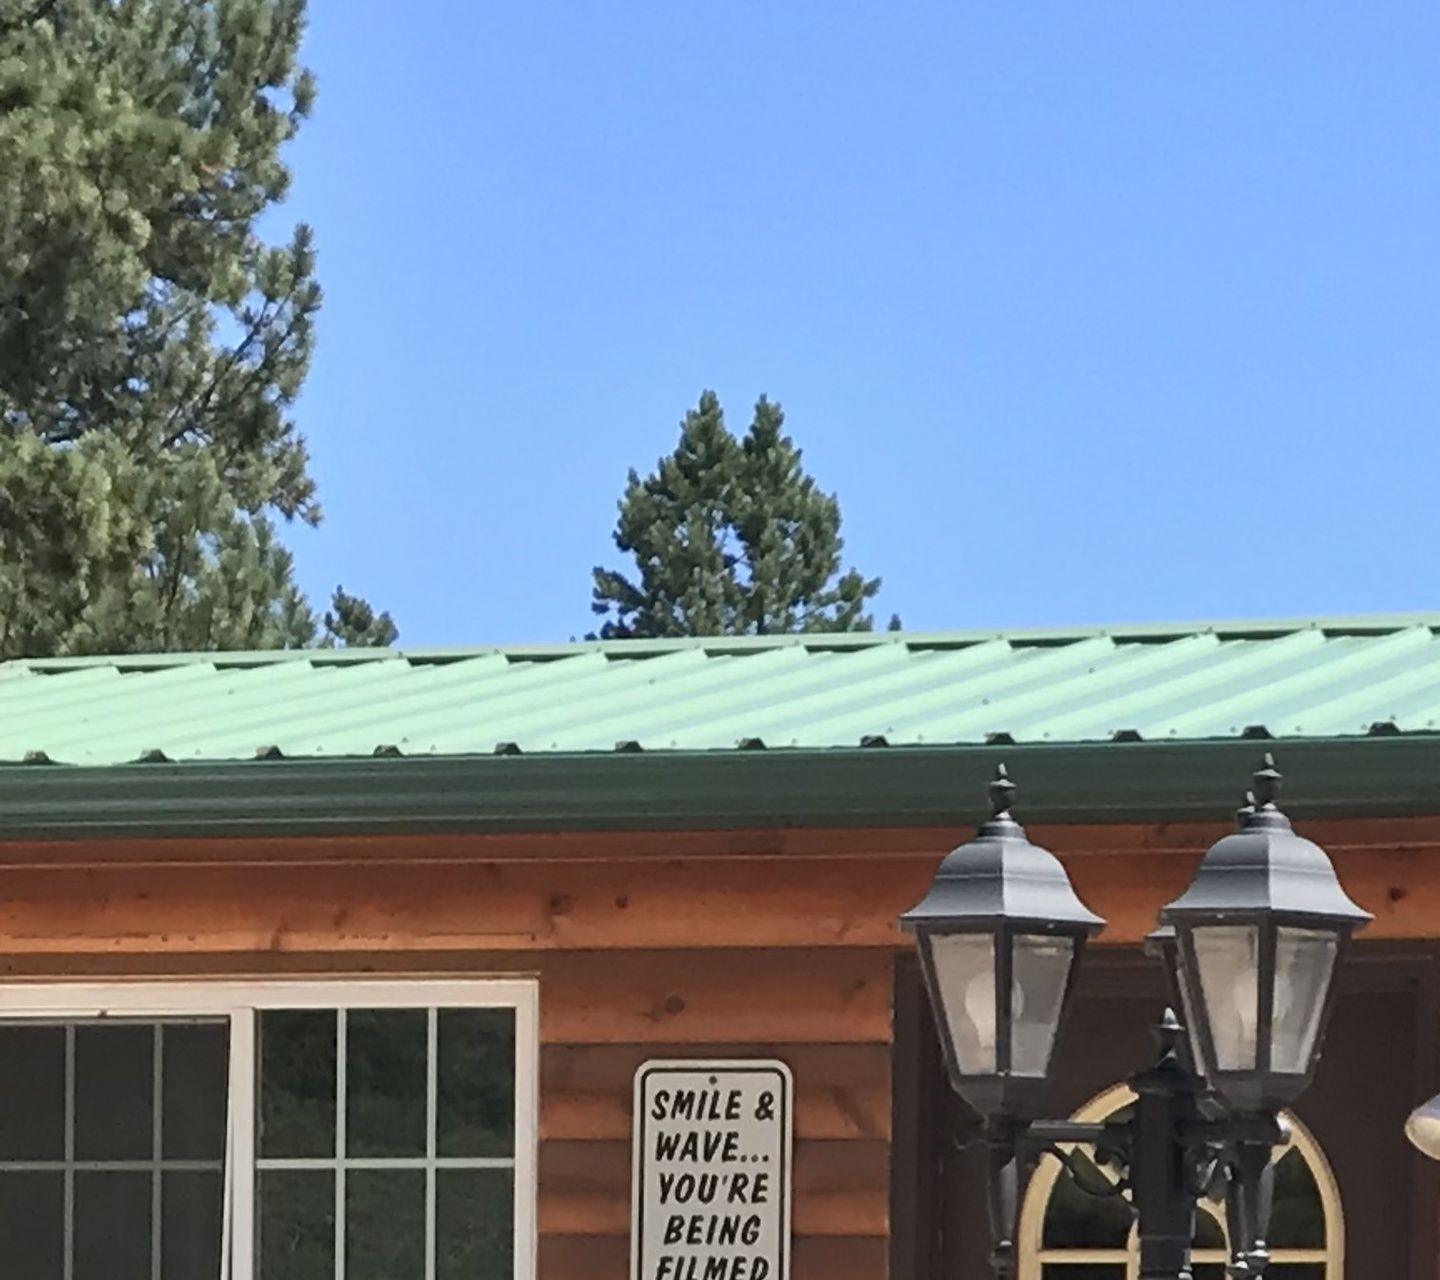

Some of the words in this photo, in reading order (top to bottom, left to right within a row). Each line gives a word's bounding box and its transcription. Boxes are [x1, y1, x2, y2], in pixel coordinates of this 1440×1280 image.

[651, 1089, 742, 1121] SMILE
[754, 1090, 775, 1121] &
[655, 1131, 770, 1163] WAVE...
[658, 1172, 769, 1204] YOU'RE
[663, 1214, 761, 1246] BEING
